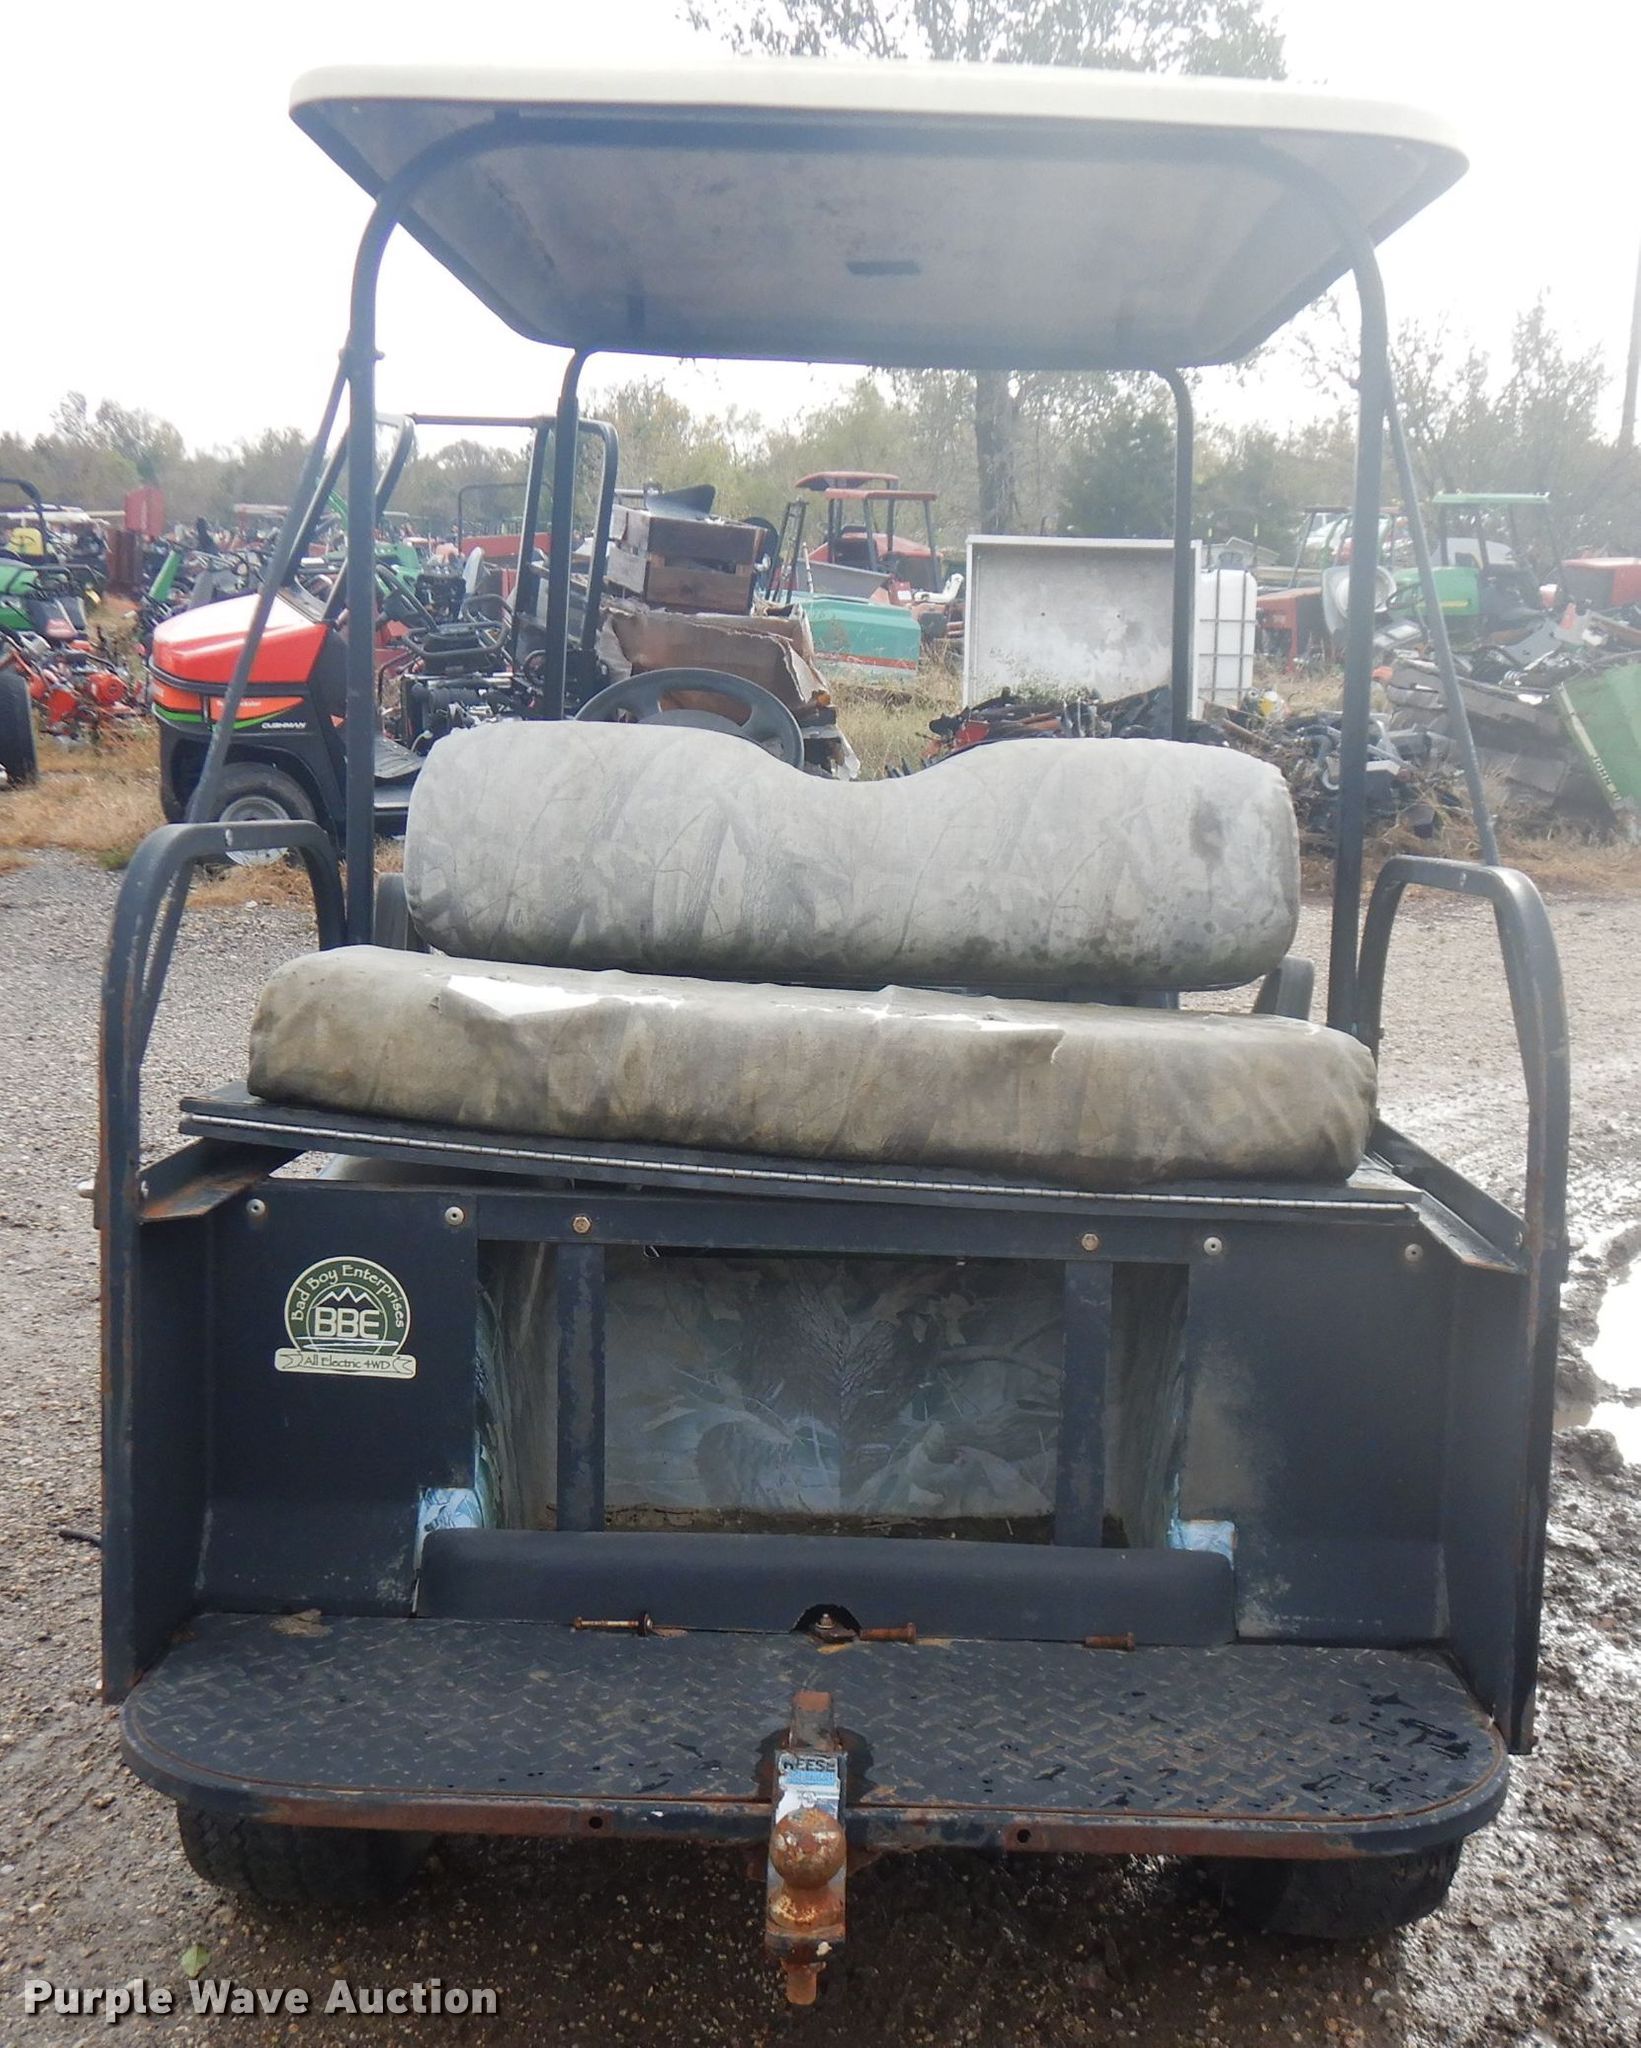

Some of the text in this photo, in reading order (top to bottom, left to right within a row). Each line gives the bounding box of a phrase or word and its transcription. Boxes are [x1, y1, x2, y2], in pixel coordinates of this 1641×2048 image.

[261, 721, 306, 730] CUSHMAN
[291, 1264, 405, 1328] Bad Boy Enterprises
[314, 1306, 380, 1339] BBE
[304, 1354, 391, 1370] All Electric 4WD
